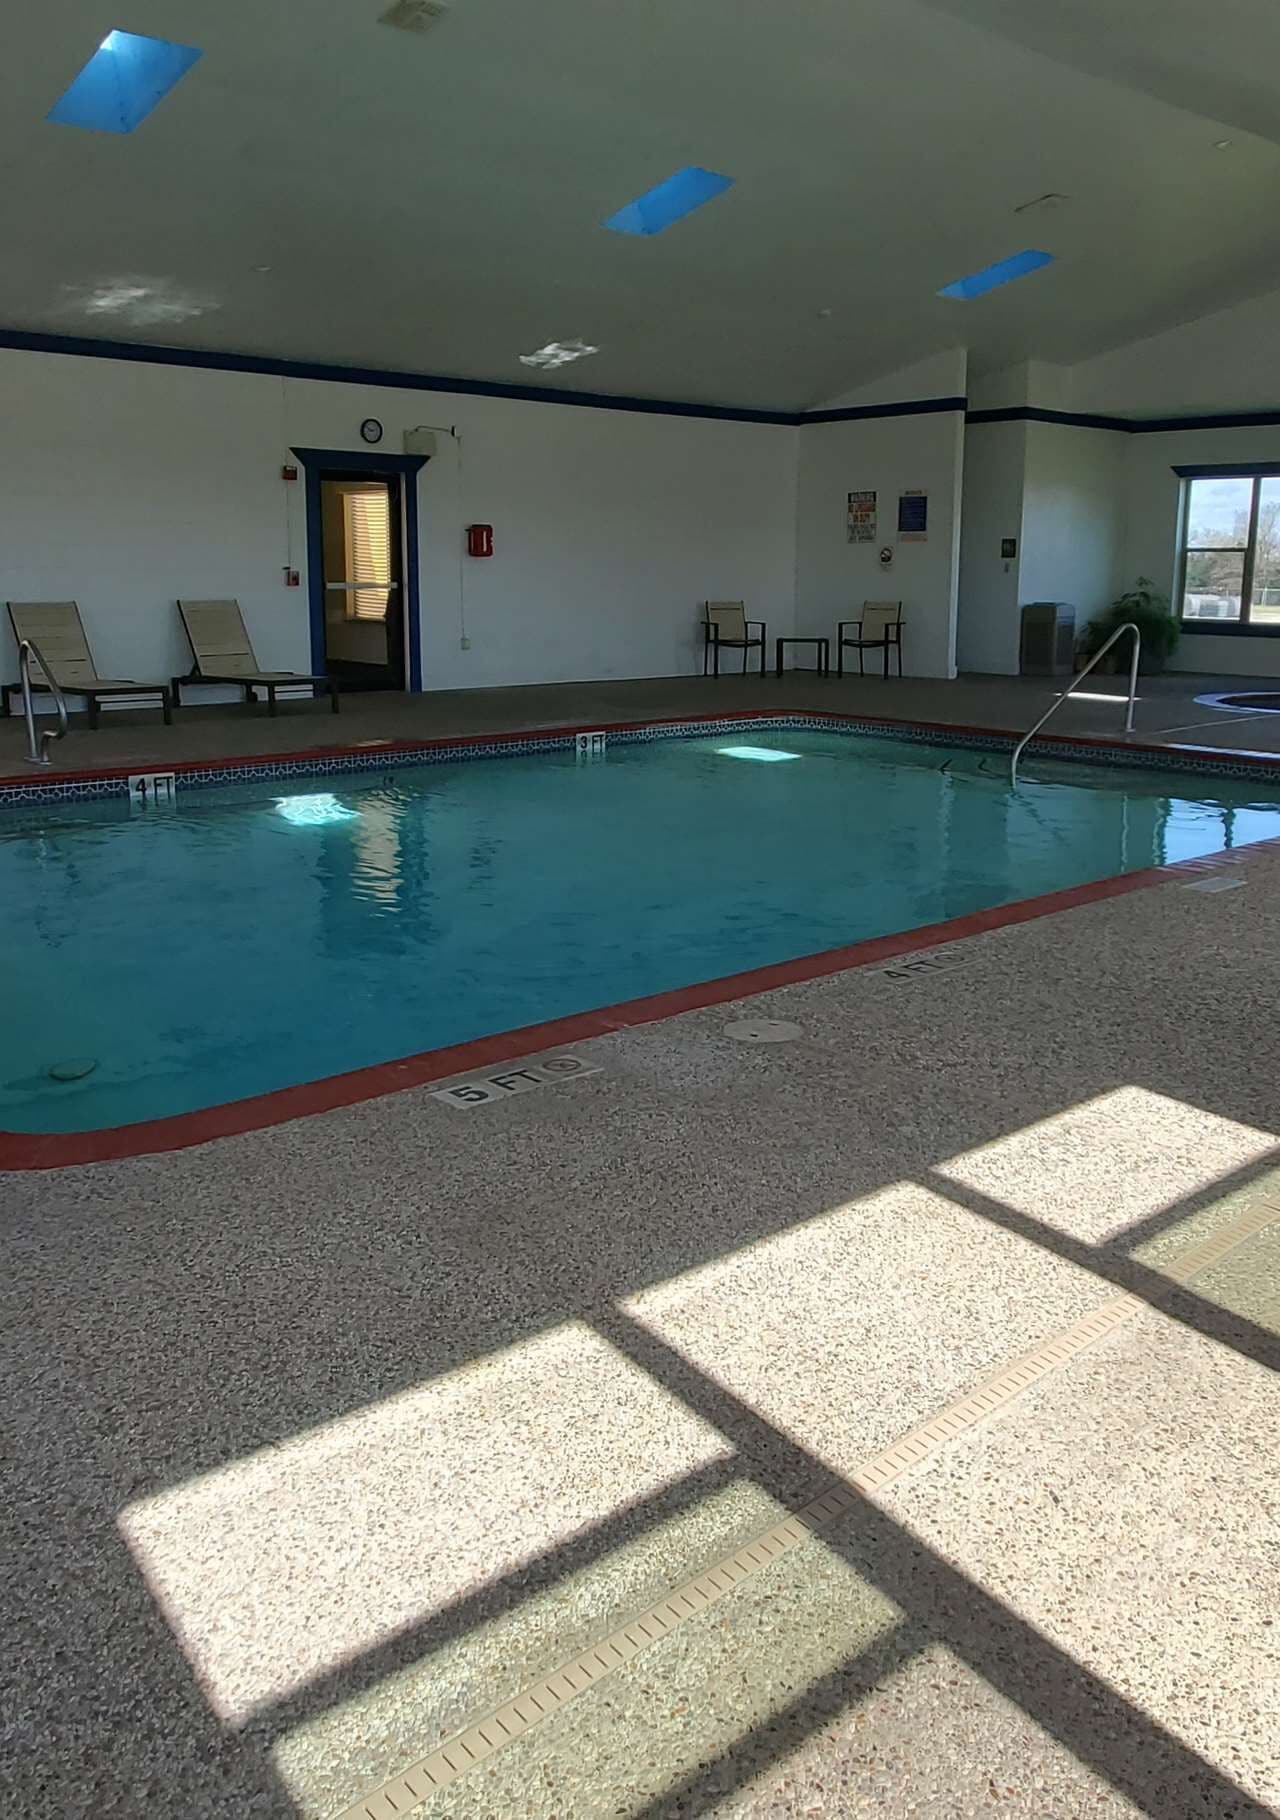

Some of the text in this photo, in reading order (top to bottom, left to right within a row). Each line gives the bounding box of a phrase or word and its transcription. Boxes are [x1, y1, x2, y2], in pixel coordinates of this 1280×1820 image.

[580, 734, 605, 752] 3 FT
[135, 775, 173, 798] 4 FT
[883, 960, 945, 978] 4 FT
[448, 1069, 543, 1102] 5 FT
